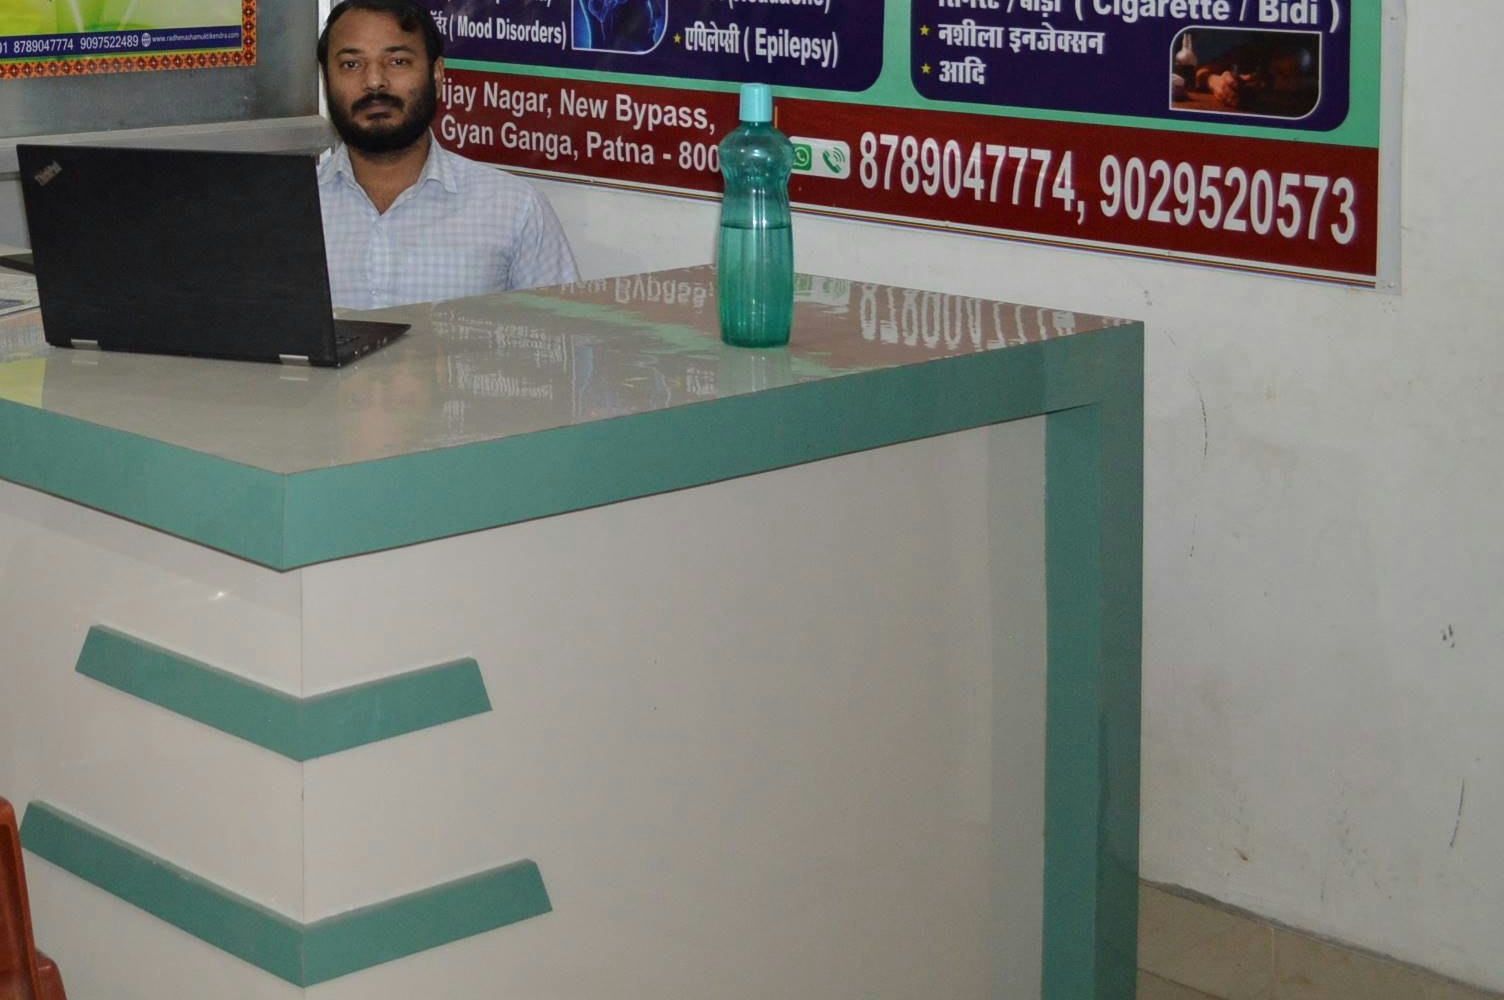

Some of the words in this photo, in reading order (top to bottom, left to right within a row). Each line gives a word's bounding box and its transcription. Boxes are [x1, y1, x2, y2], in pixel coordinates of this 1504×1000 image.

[13, 38, 74, 53] 8789047774
[79, 34, 139, 50] 9097522489
[937, 18, 1005, 48] नशीला
[938, 55, 986, 84] आदि
[442, 78, 476, 112] ijay
[483, 81, 551, 118] Nagar,
[560, 88, 608, 119] New
[616, 93, 714, 135] Bypass,
[441, 114, 493, 148] Gyan
[500, 121, 578, 160] Ganga,
[586, 131, 654, 165] Patna
[1099, 154, 1355, 244] 9029520573
